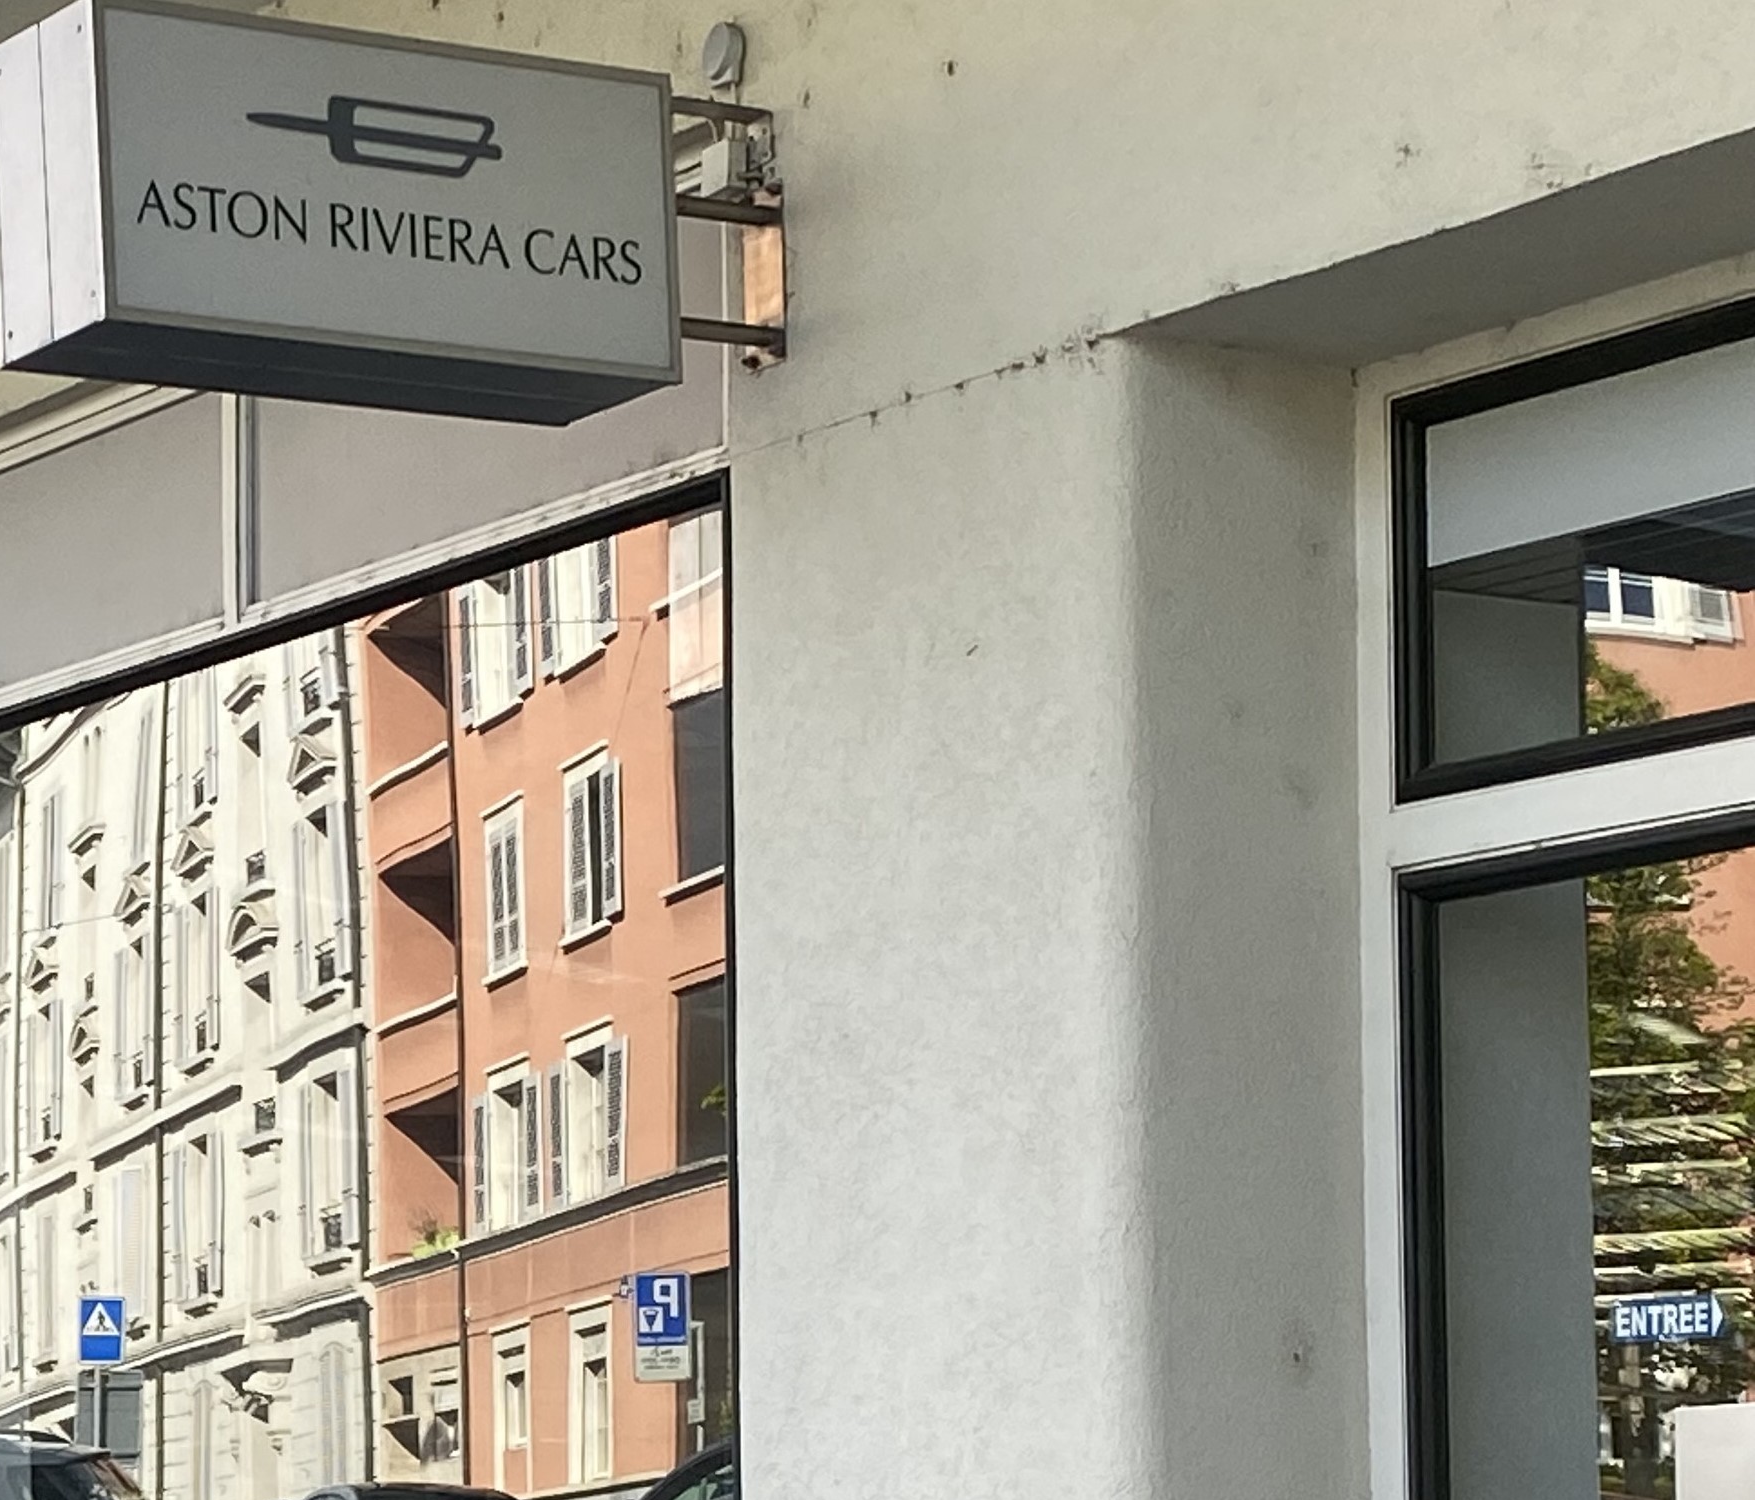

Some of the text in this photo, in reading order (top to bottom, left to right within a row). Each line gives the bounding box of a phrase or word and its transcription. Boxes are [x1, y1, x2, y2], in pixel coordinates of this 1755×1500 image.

[137, 180, 642, 286] ASTON RIVIERA CARS
[1615, 1302, 1708, 1338] ENTREE
